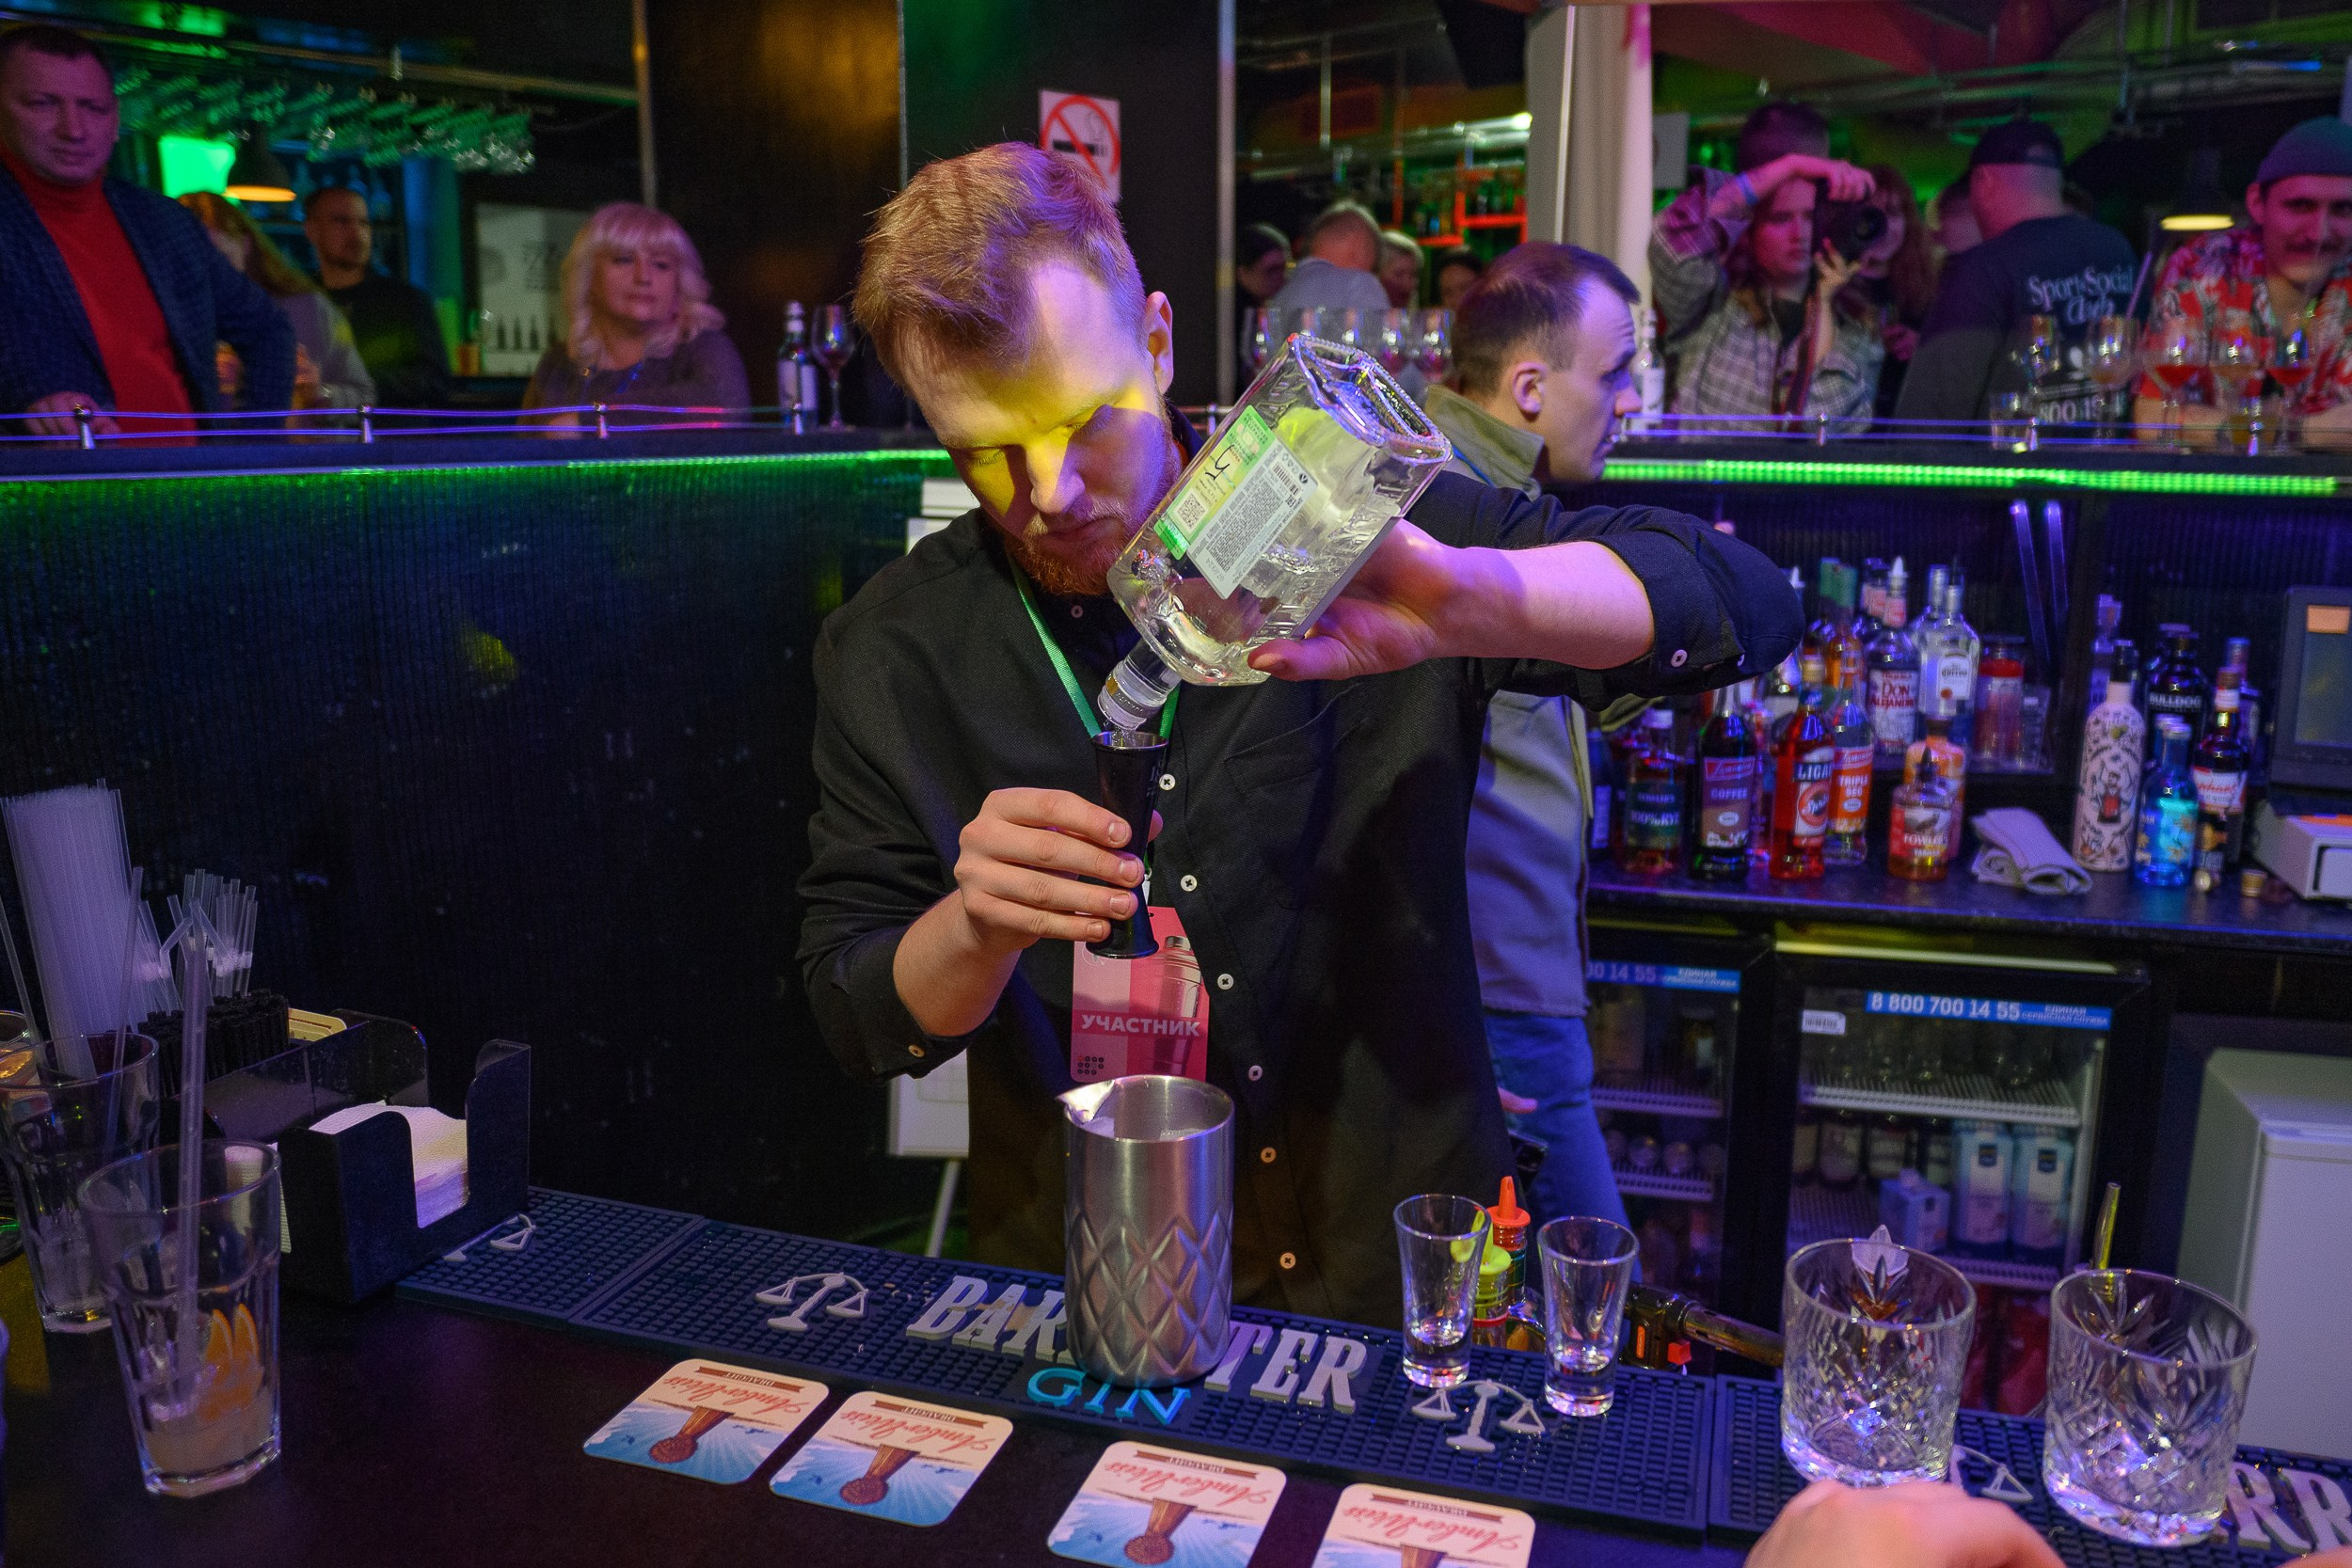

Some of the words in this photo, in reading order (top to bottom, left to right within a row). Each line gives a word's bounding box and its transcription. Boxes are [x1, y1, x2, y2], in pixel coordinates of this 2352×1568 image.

[1883, 683, 1910, 698] DON
[2150, 691, 2201, 708] BULLDOG
[1710, 787, 1748, 800] COFFEE
[1611, 962, 1628, 981] 14
[1871, 992, 1883, 1011] 8
[1888, 993, 1924, 1014] 800
[1929, 995, 1964, 1017] 700
[1969, 999, 1991, 1019] 14
[1995, 1001, 2021, 1022] 55
[2045, 1004, 2087, 1015] ЕДИНАЯ
[1082, 1014, 1200, 1037] УЧАСТНИК
[723, 1371, 775, 1387] DRAUGHT
[1027, 1367, 1192, 1425] GIN
[901, 1406, 956, 1422] DRAUGHT
[1168, 1457, 1226, 1474] DRAUGHT
[1406, 1499, 1469, 1516] DRAUGHT
